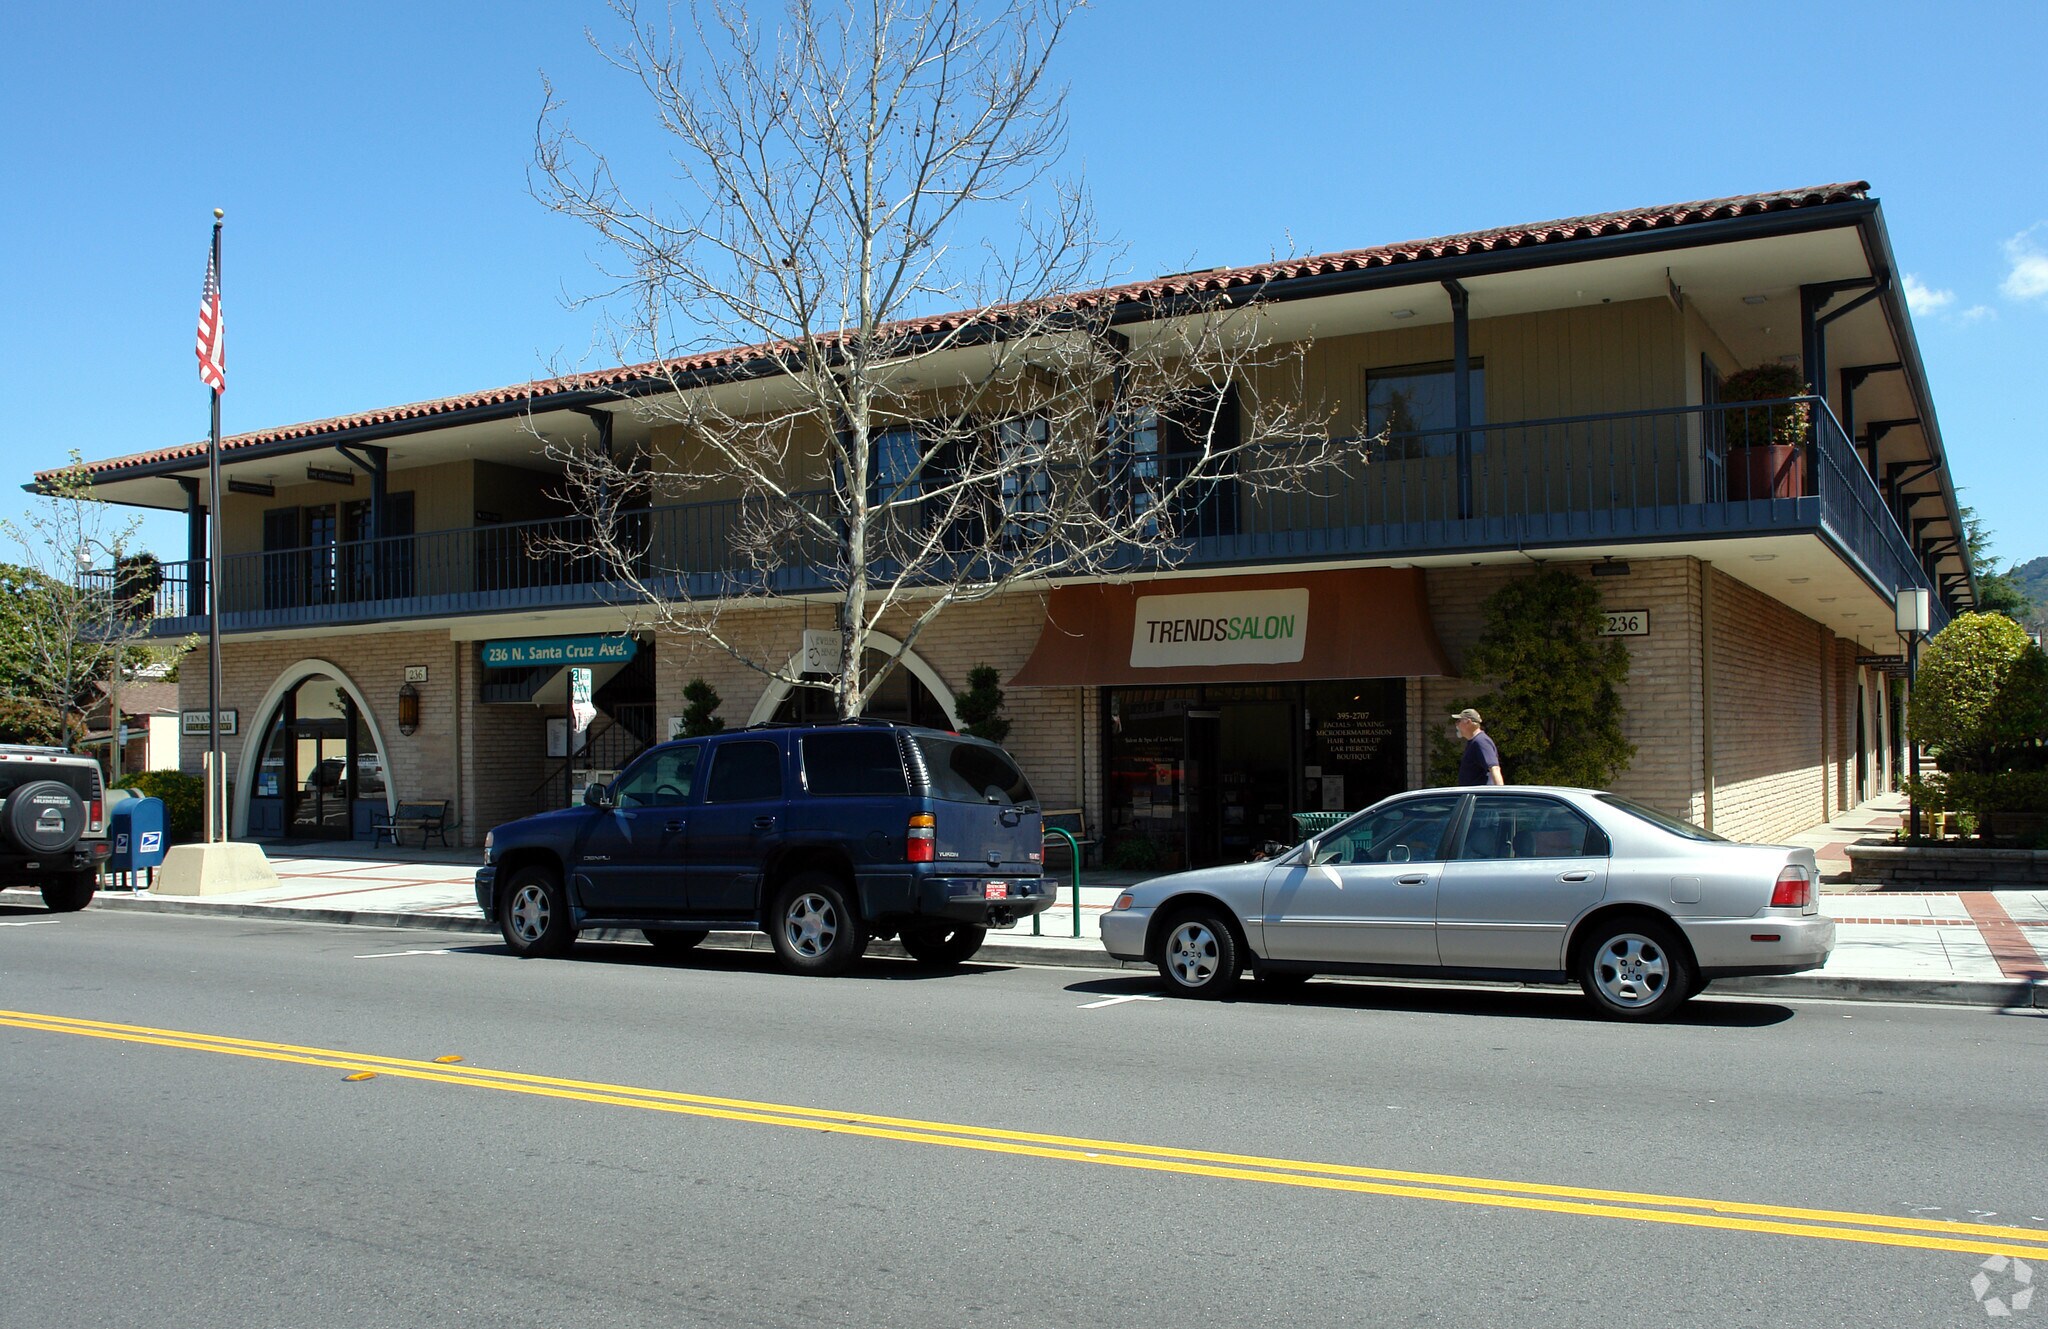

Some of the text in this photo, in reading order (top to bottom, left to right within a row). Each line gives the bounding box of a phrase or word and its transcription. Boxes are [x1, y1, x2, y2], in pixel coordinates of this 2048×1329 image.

[1607, 615, 1639, 632] 236
[489, 642, 628, 661] 236 N. Santa Cruz Ave.
[409, 669, 423, 680] 236
[572, 670, 579, 681] 2
[1336, 712, 1370, 720] 395-2707
